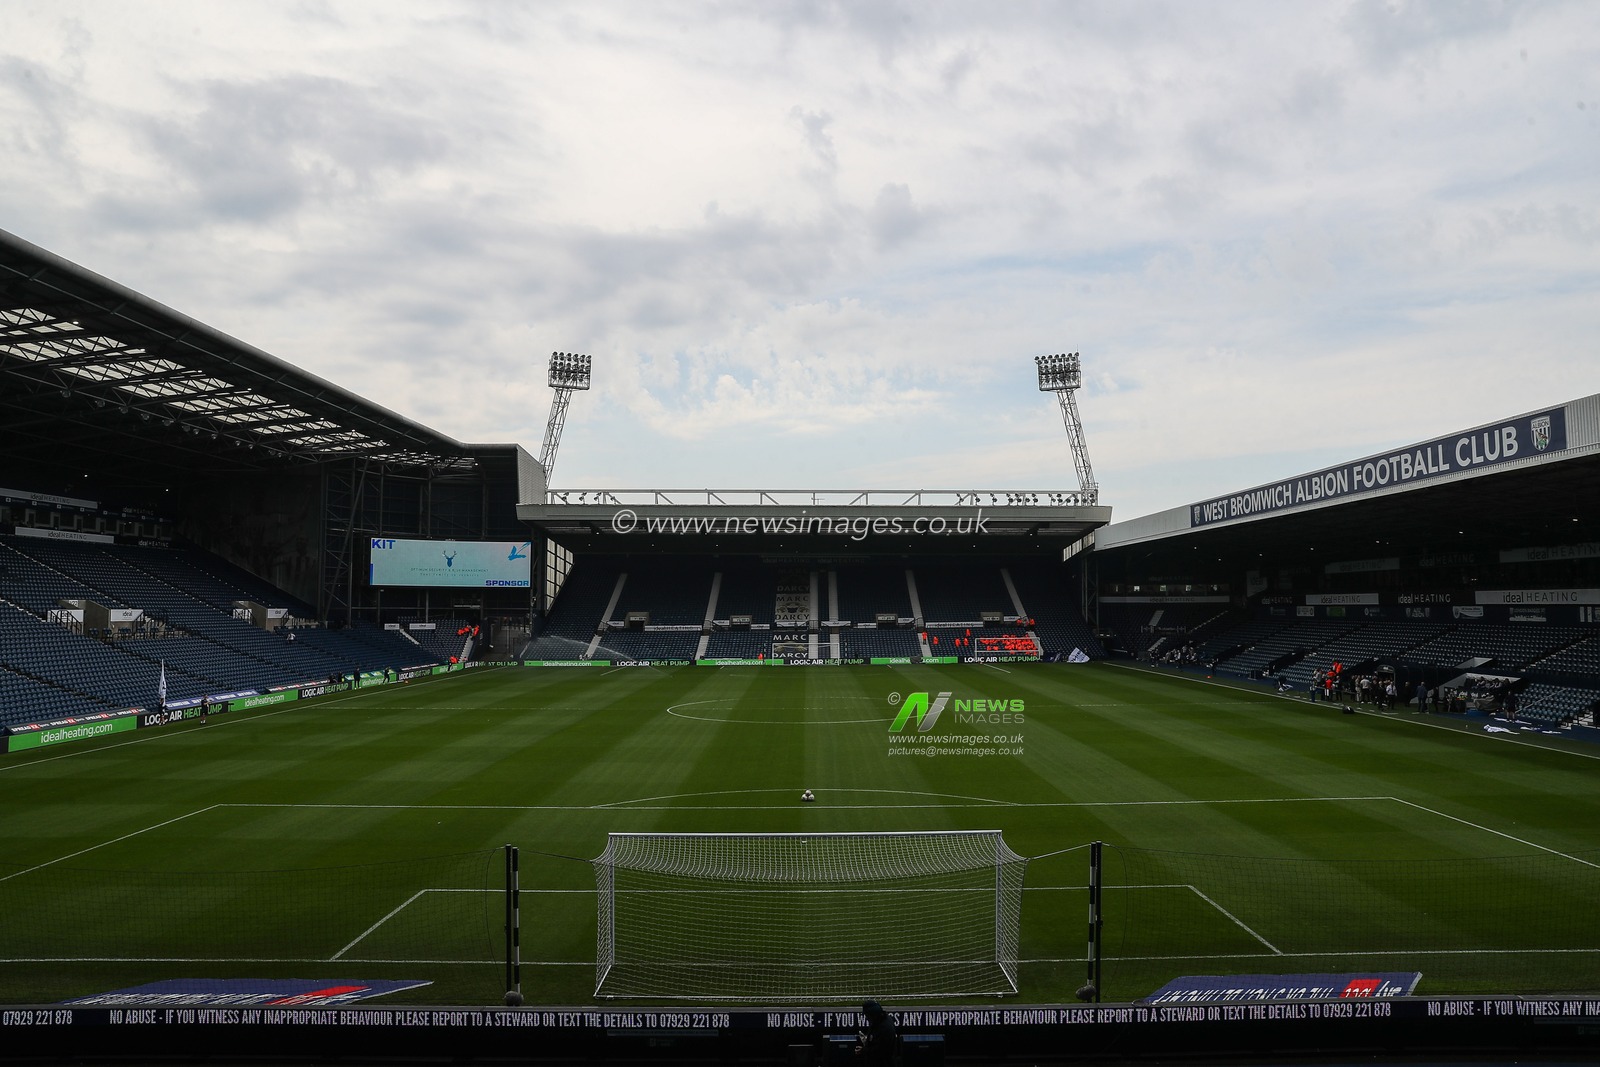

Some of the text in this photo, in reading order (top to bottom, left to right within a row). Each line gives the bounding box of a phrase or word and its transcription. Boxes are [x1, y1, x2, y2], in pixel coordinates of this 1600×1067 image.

[1203, 426, 1518, 521] WEST BROMWICH ALBION FOOTBALL CLUB
[372, 539, 395, 549] KIT
[245, 694, 285, 707] idealheating.com
[302, 687, 316, 698] LOGIC
[316, 686, 325, 696] AIR
[144, 713, 168, 726] LOGC
[169, 710, 182, 722] AIR
[183, 707, 202, 719] HEAT
[41, 723, 113, 743] idealheating.com
[767, 1013, 781, 1027] NO
[783, 1012, 815, 1027] ABUSE
[824, 1012, 833, 1027] IF
[834, 1012, 854, 1027] YOU
[902, 1011, 923, 1026] ANY
[925, 1010, 1001, 1026] INAPPROPRIATE
[1004, 1009, 1057, 1025] BEHAVIOUR
[1060, 1009, 1095, 1024] PLEASE
[1098, 1008, 1134, 1023] REPORT
[1136, 1008, 1148, 1022] TO
[1150, 1008, 1158, 1022] A
[1160, 1006, 1204, 1022] STEWARD
[1208, 1006, 1220, 1021] OR
[1222, 1005, 1246, 1021] TEXT
[1248, 1005, 1266, 1020] THE
[1268, 1004, 1306, 1019] DETAILS
[1308, 1003, 1321, 1018] TO
[1323, 1003, 1352, 1018] 07929
[1355, 1002, 1372, 1017] 221
[1374, 1002, 1391, 1017] 878
[1428, 1001, 1441, 1016] NO
[1443, 1001, 1474, 1016] ABUSE
[1484, 1001, 1492, 1015] IF
[1494, 1001, 1513, 1015] YOU
[1516, 1001, 1560, 1016] WITNESS
[1562, 1001, 1583, 1016] ANY
[3, 1010, 73, 1025] 07929 221 878
[110, 1009, 122, 1024] NO
[126, 1009, 156, 1024] ABUSE
[166, 1009, 174, 1024] IF
[177, 1009, 195, 1024] YOU
[198, 1009, 240, 1024] WITNESS
[241, 1009, 261, 1024] ANY
[264, 1010, 337, 1025] INAPPROPRIATE
[340, 1010, 392, 1025] BEHAVIOUR
[396, 1011, 430, 1026] PLEASE
[432, 1011, 469, 1026] REPORT
[470, 1012, 482, 1026] TO
[485, 1012, 493, 1026] A
[494, 1012, 539, 1027] STEWARD
[543, 1012, 555, 1027] OR
[558, 1012, 581, 1027] TEXT
[583, 1012, 602, 1028] THE
[604, 1013, 642, 1028] DETAILS
[645, 1013, 657, 1028] TO
[660, 1013, 690, 1028] 07929
[692, 1013, 709, 1028] 221
[712, 1013, 730, 1028] 878
